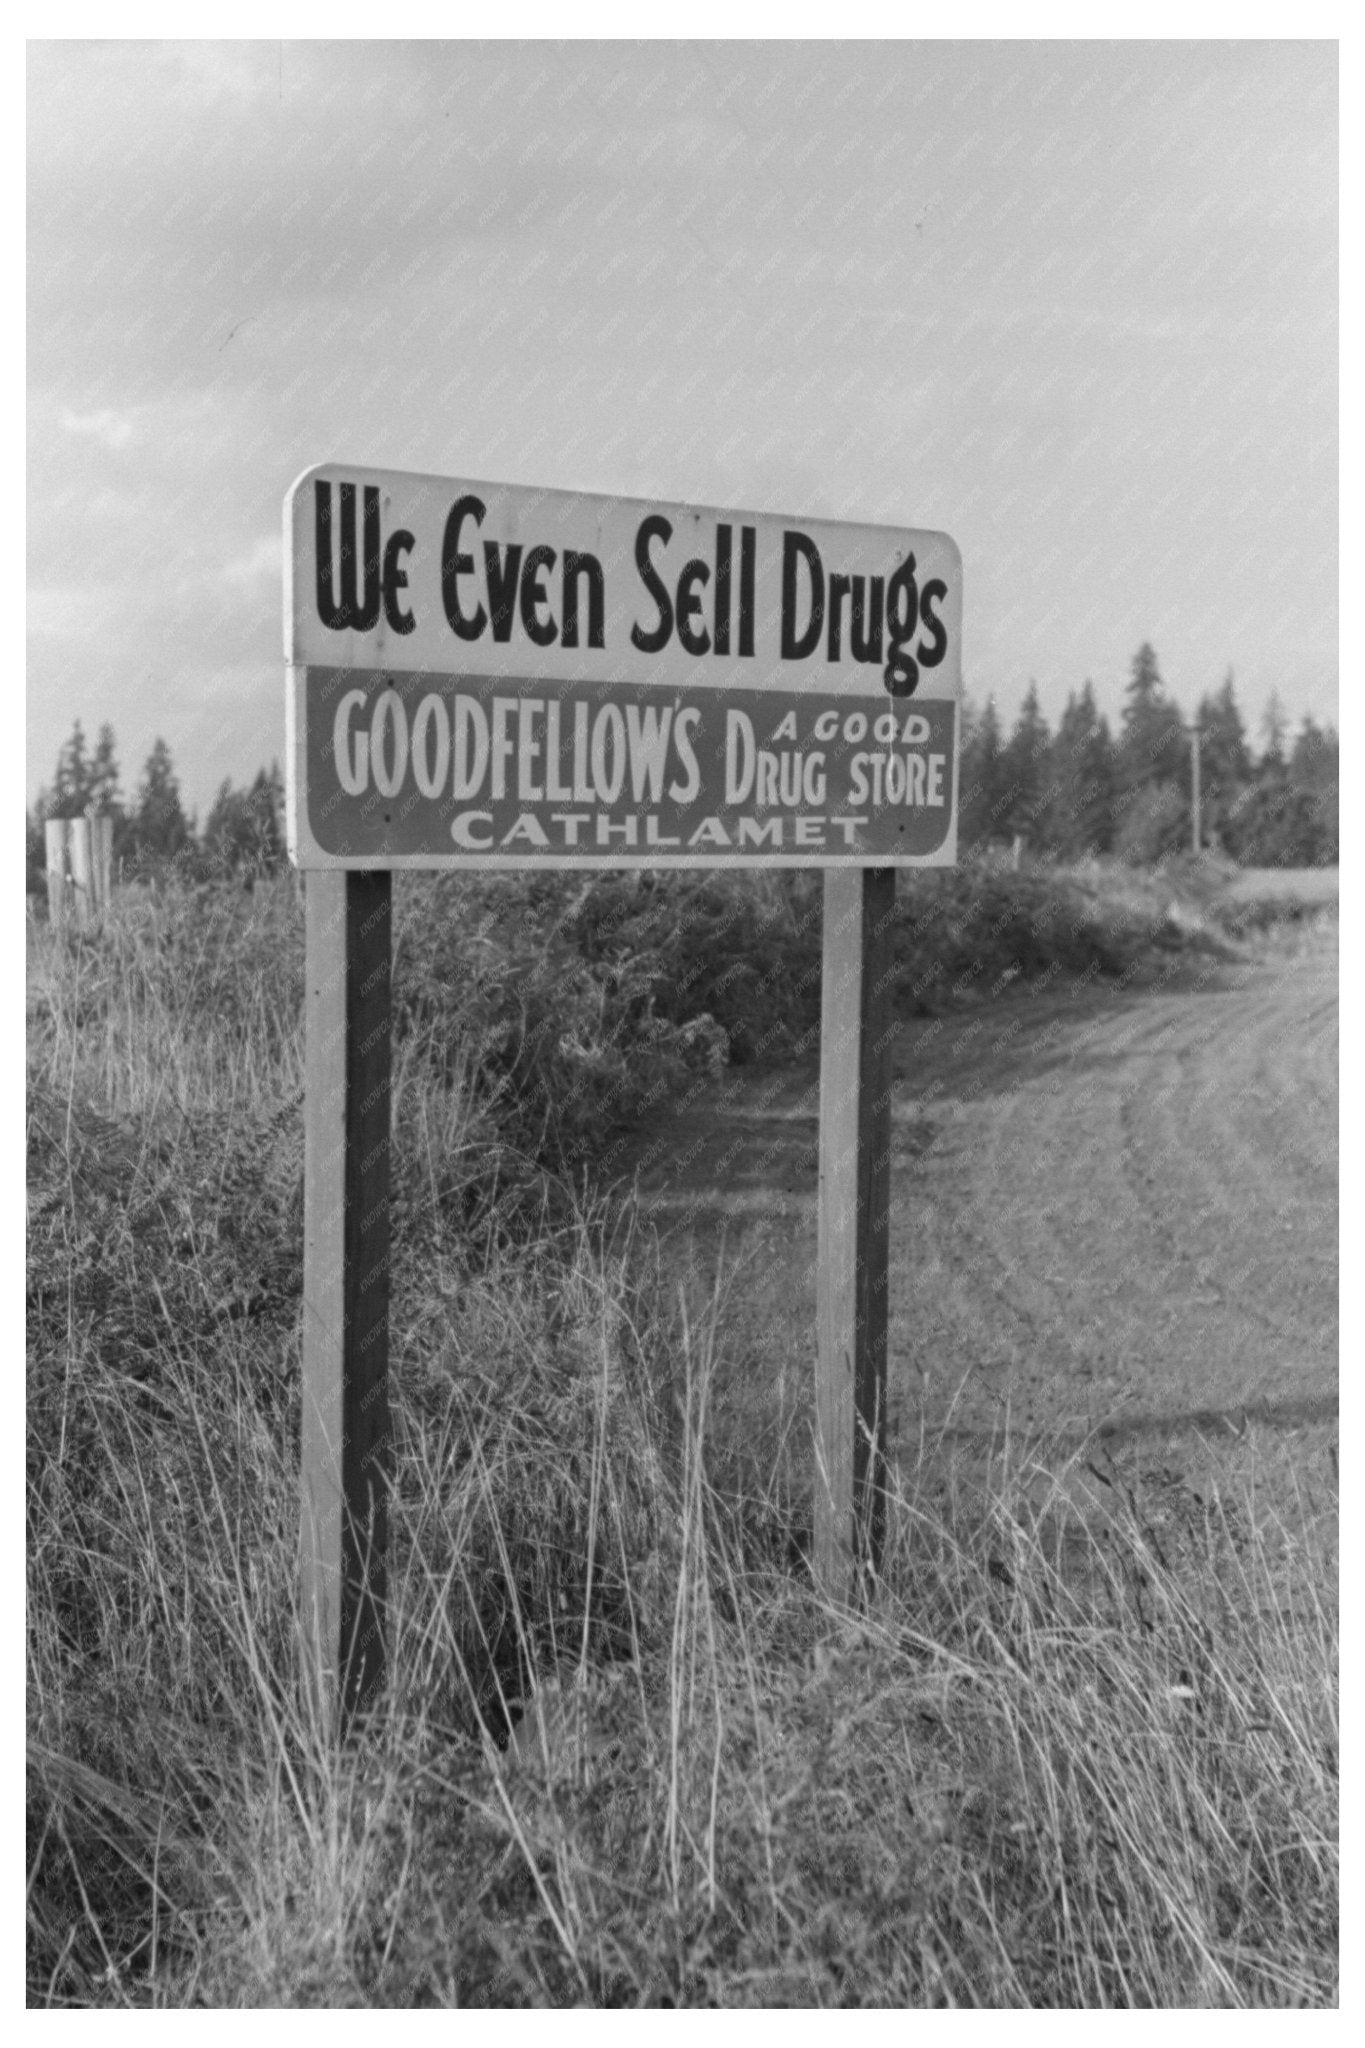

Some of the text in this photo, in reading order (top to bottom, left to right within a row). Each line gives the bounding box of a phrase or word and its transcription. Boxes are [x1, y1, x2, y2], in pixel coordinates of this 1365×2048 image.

[315, 480, 948, 698] We Even Sell Drugs
[333, 689, 946, 807] GOODFELLOW'S DRUG STORE
[773, 711, 931, 744] A GOOD
[450, 811, 869, 850] CATHLAMET
